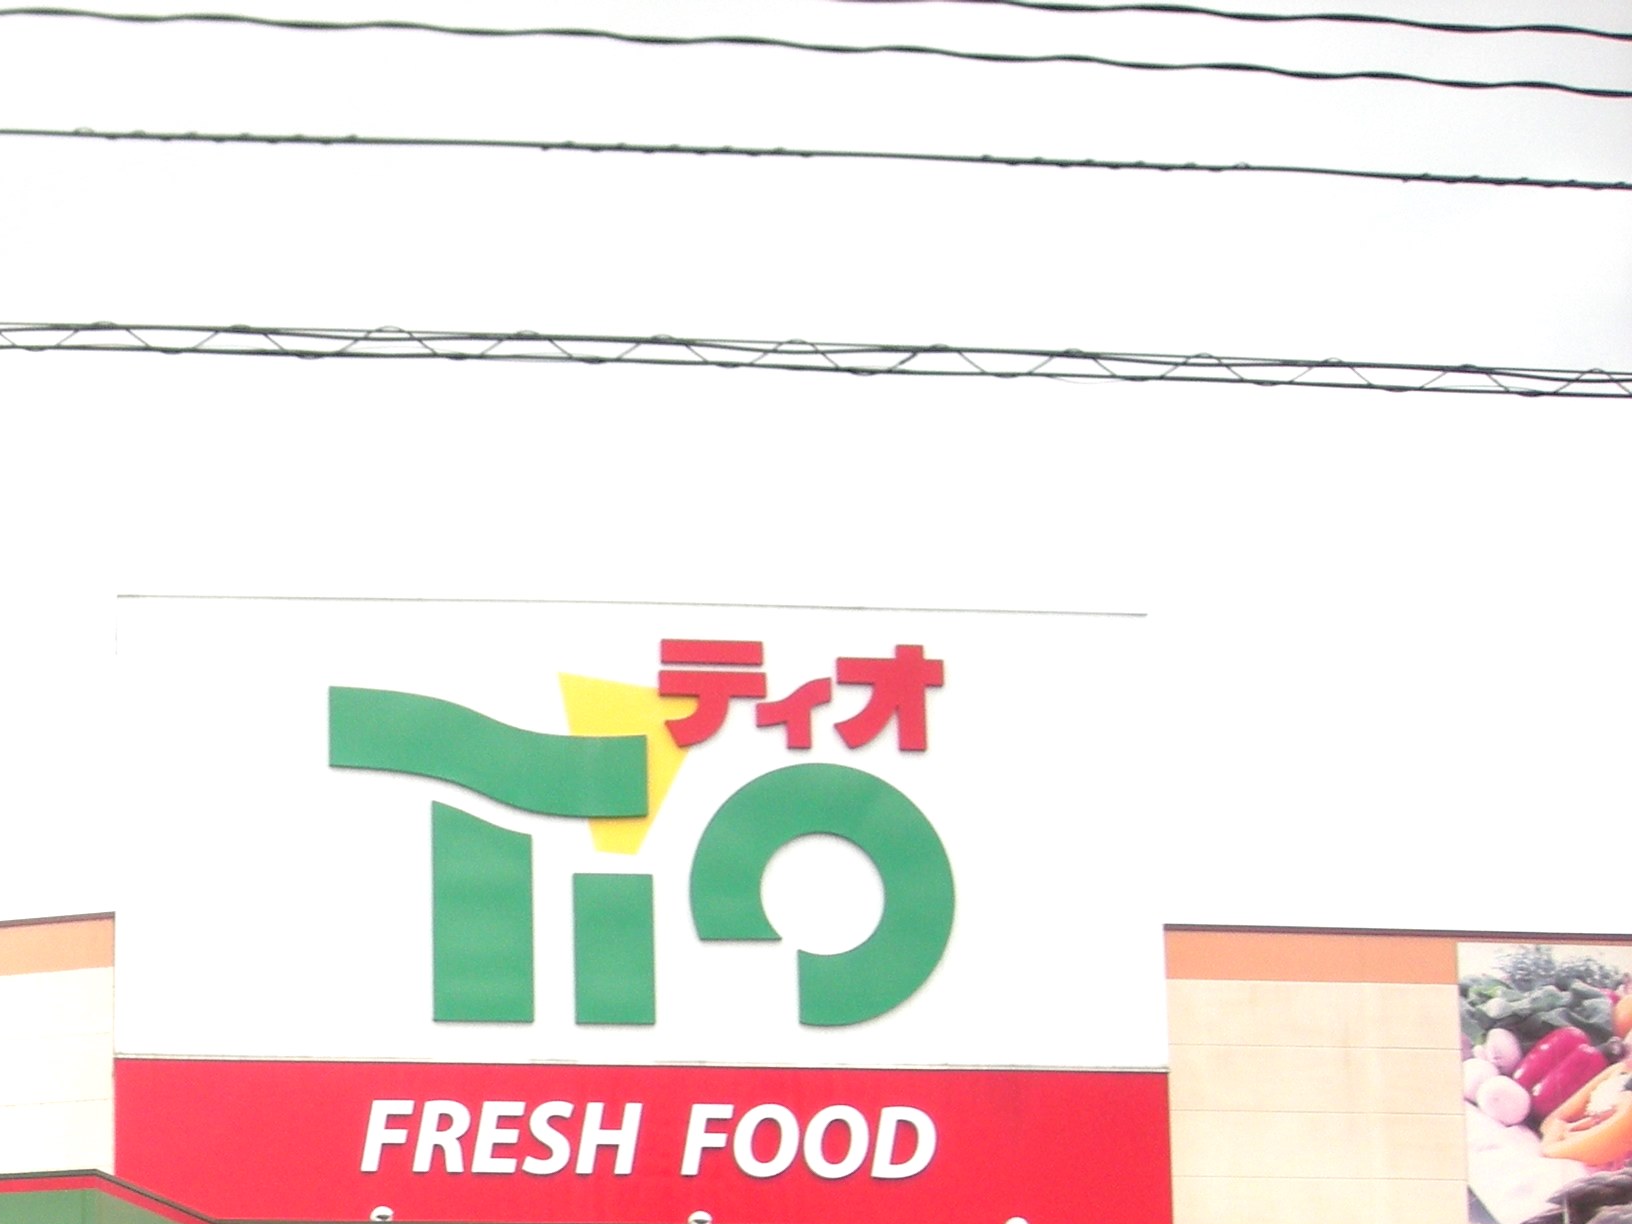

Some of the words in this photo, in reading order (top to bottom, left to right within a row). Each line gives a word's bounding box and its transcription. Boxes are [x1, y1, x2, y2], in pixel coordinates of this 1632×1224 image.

[658, 638, 945, 752] ティオ
[360, 1099, 643, 1176] FRESH
[680, 1103, 937, 1180] FOOD
